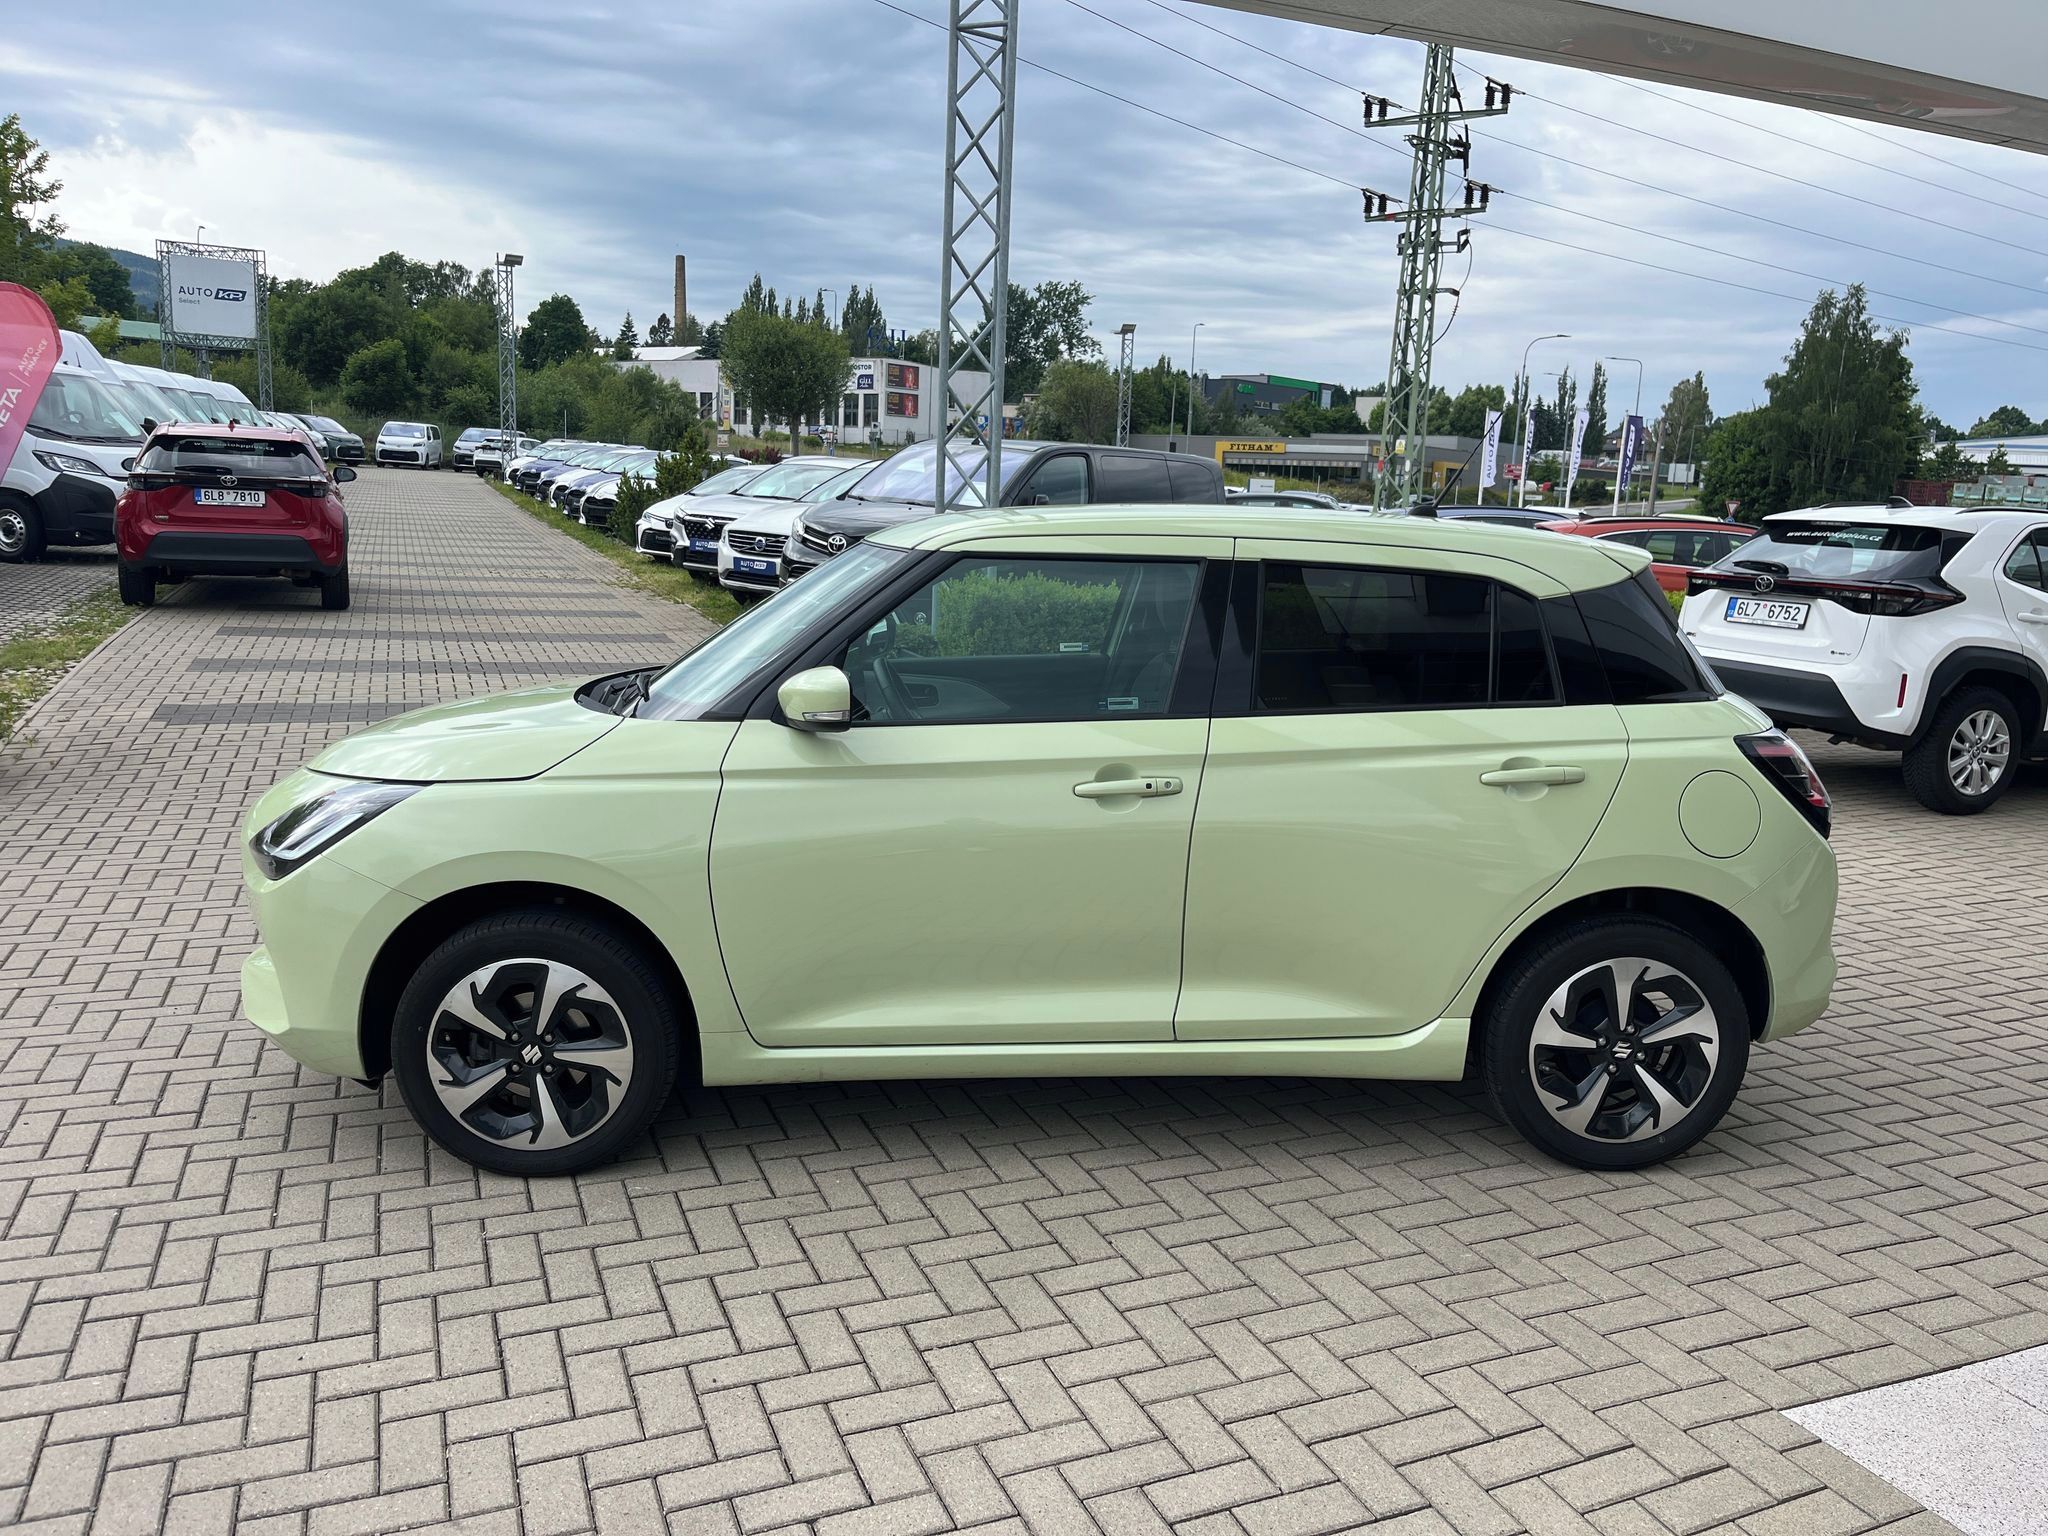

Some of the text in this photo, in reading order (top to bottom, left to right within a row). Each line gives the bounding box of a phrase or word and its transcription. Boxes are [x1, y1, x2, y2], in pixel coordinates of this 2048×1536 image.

[178, 285, 213, 297] AUTO
[178, 297, 200, 305] Select
[18, 346, 34, 371] AUTO
[24, 338, 48, 376] FINANCE
[0, 388, 22, 428] ETA
[1229, 443, 1273, 452] FITHAM
[203, 490, 260, 502] 6L8 7810
[1786, 530, 1883, 542] www.autokpplus.cz
[740, 560, 754, 568] AUTO
[1736, 601, 1761, 617] 6L7
[1767, 604, 1801, 622] 6752
